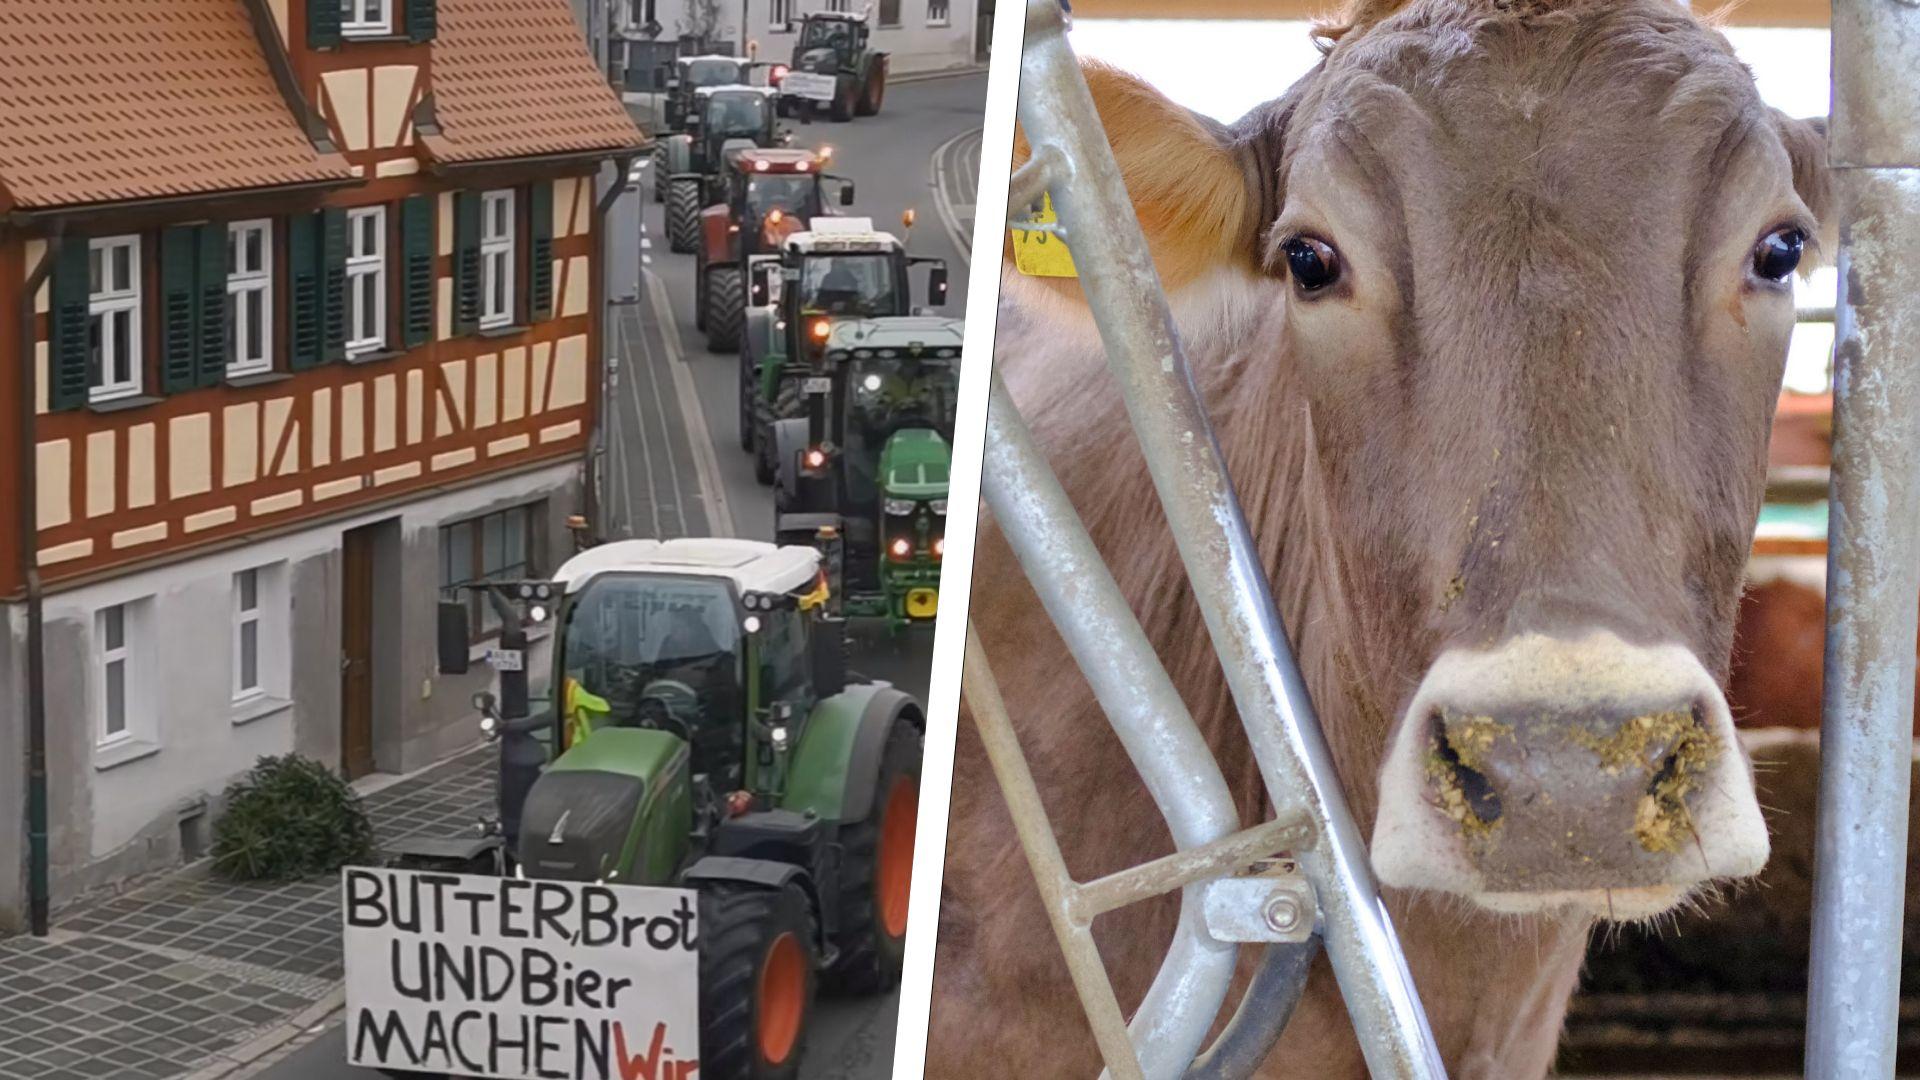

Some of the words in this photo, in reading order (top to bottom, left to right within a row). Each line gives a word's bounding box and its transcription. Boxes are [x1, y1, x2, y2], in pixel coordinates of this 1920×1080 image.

[581, 886, 699, 950] Brot
[392, 939, 515, 1002] UND
[521, 948, 632, 1008] Bier
[353, 1008, 610, 1080] MACHEN
[613, 1020, 699, 1080] Wir
